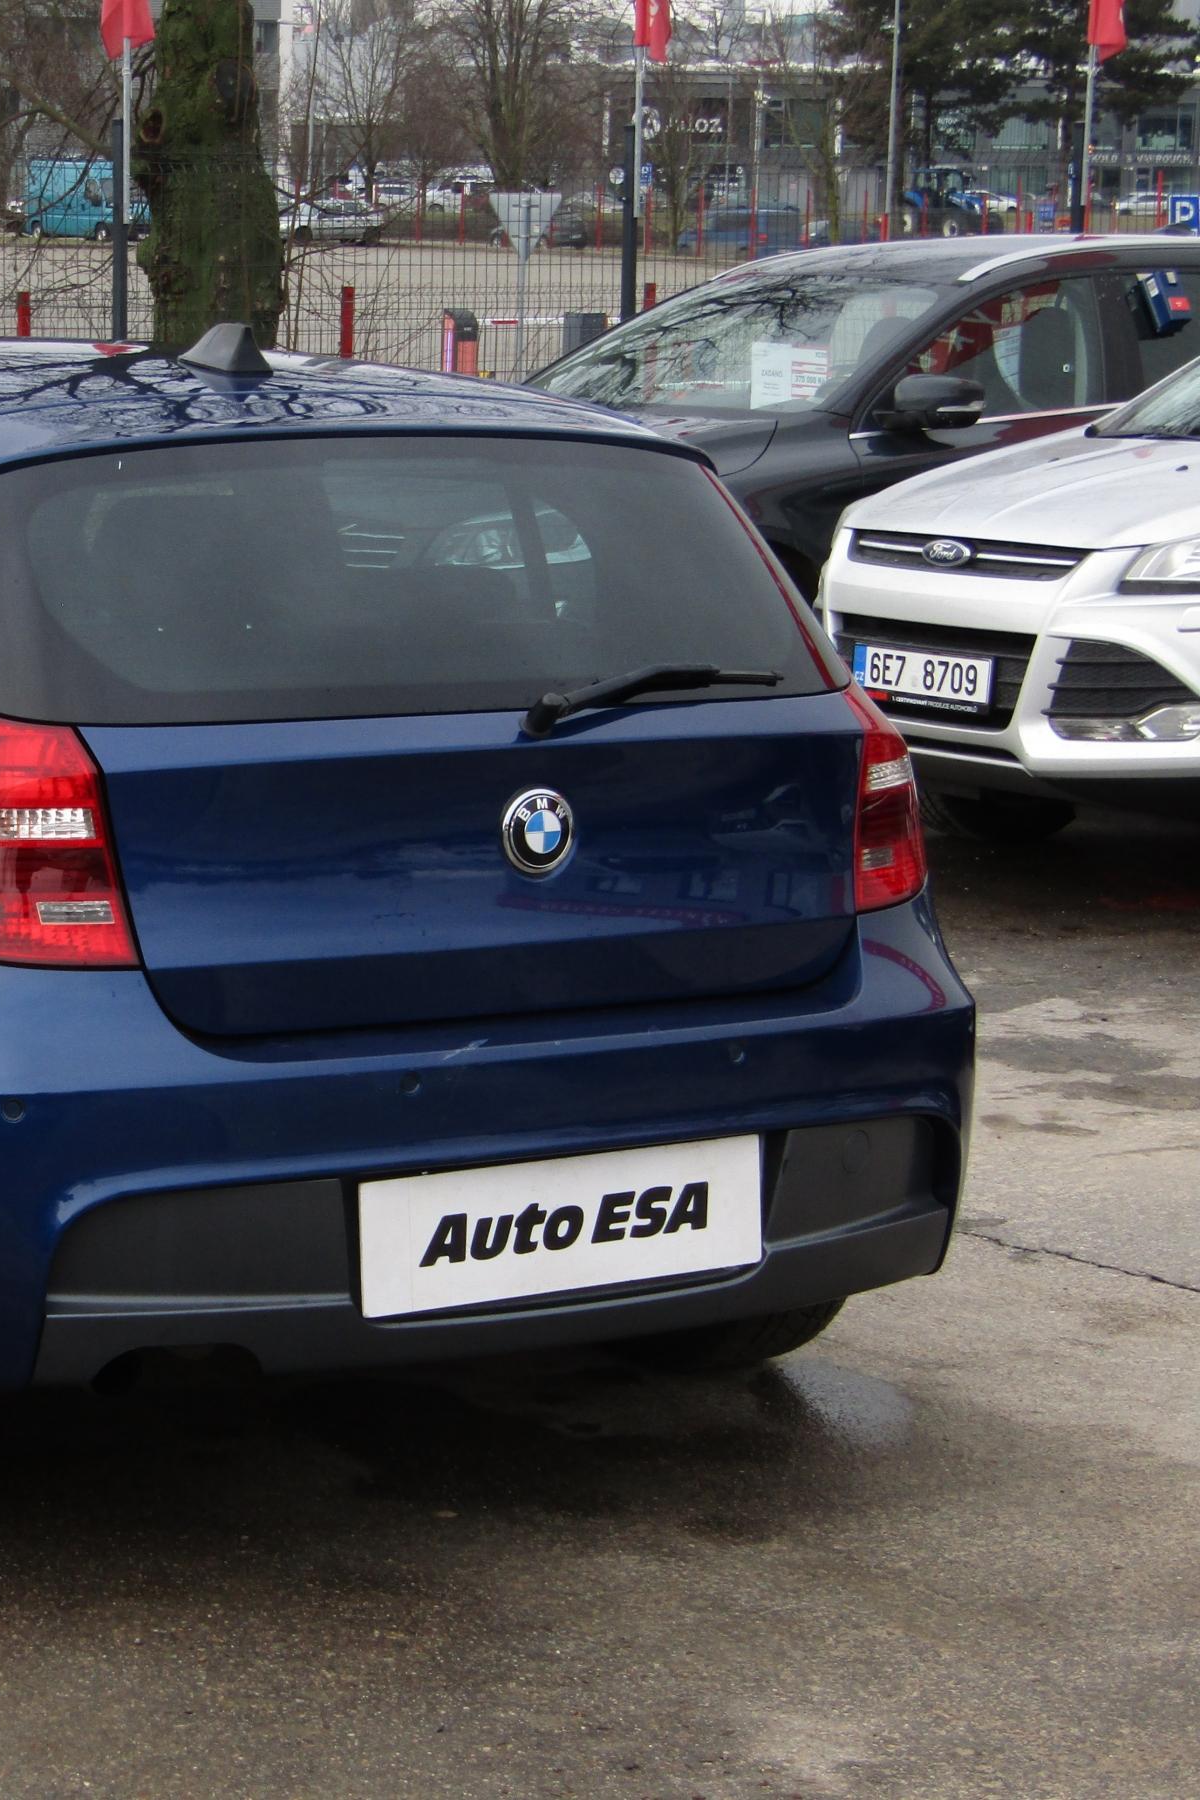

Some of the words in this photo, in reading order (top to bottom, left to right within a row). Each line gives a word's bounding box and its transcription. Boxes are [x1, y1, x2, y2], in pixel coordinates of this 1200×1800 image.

[1175, 201, 1195, 223] P
[930, 543, 957, 560] Ford
[855, 671, 865, 681] CZ
[870, 652, 906, 687] 6E7
[922, 659, 978, 696] 8709
[517, 798, 567, 822] BMW
[419, 1203, 584, 1267] Auto
[591, 1181, 709, 1244] ESA
